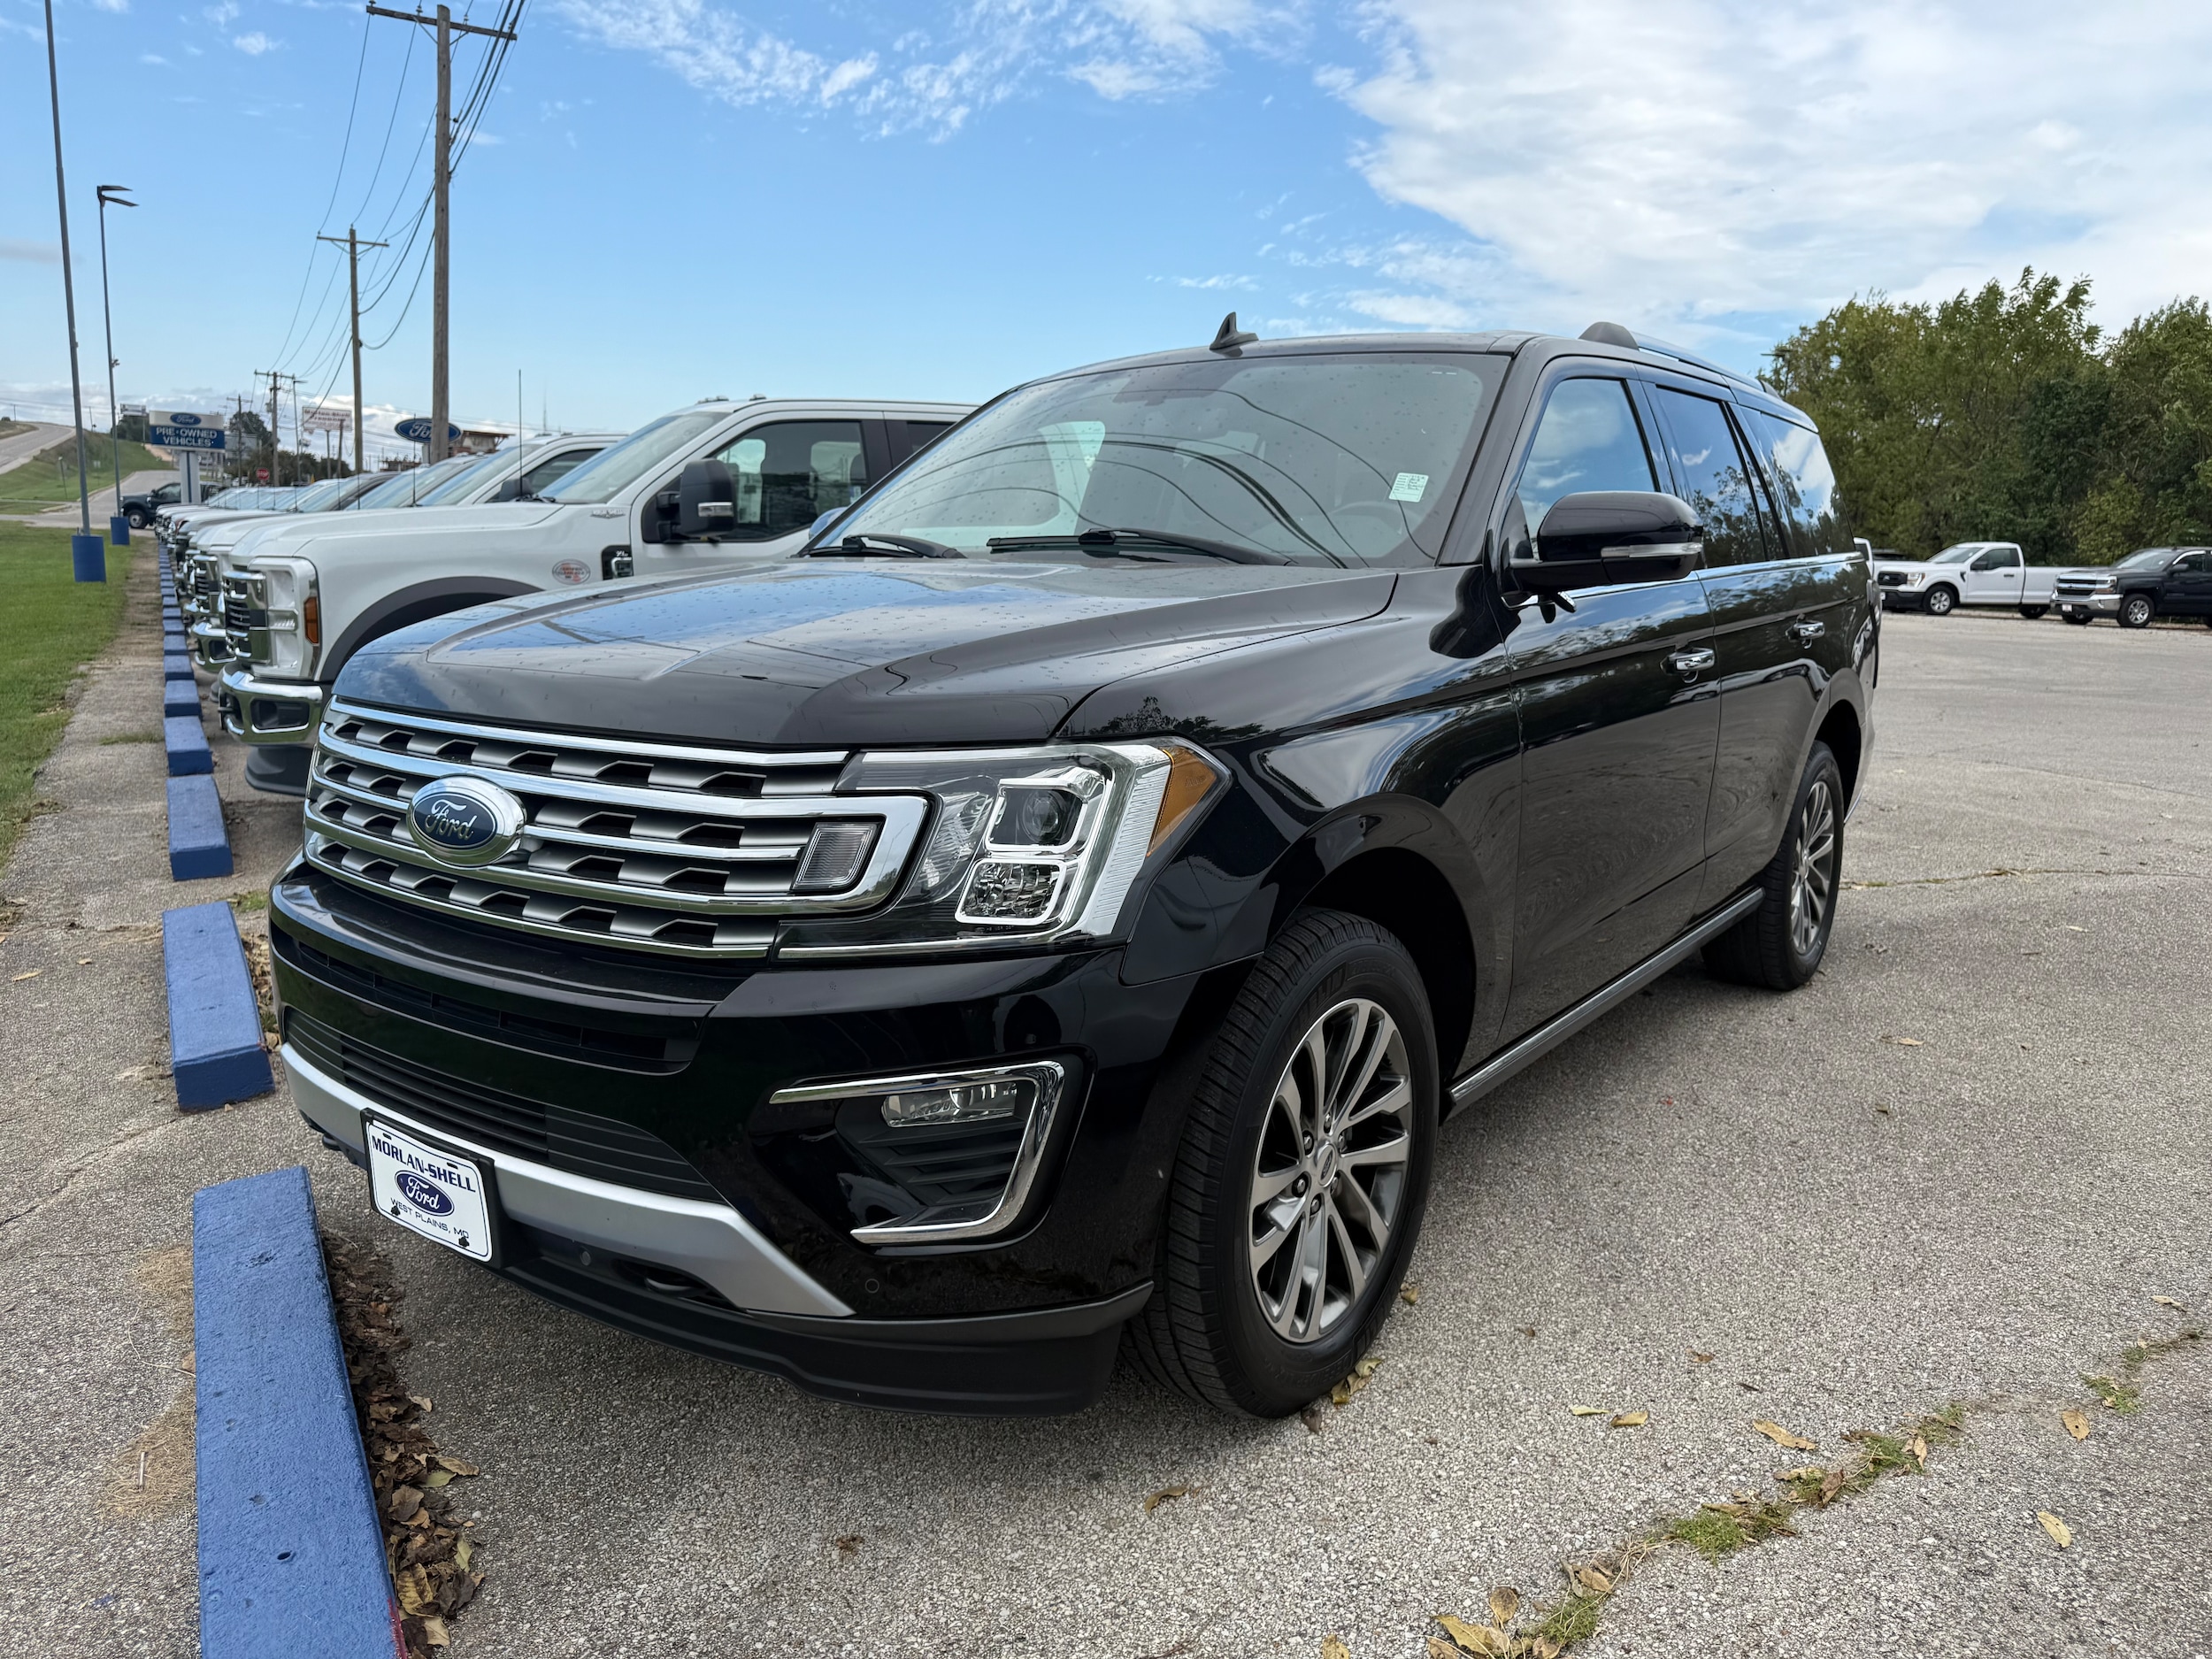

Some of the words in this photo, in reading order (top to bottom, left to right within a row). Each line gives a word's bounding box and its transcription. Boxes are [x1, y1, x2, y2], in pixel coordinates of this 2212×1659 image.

[176, 415, 195, 424] Ford
[409, 421, 433, 439] Fo
[425, 799, 478, 841] Ford
[372, 1135, 477, 1194] MORLAN-SHELL
[405, 1176, 442, 1210] Ford
[390, 1197, 413, 1215] WEST
[415, 1213, 451, 1233] PLAINS,
[454, 1227, 469, 1239] MO
